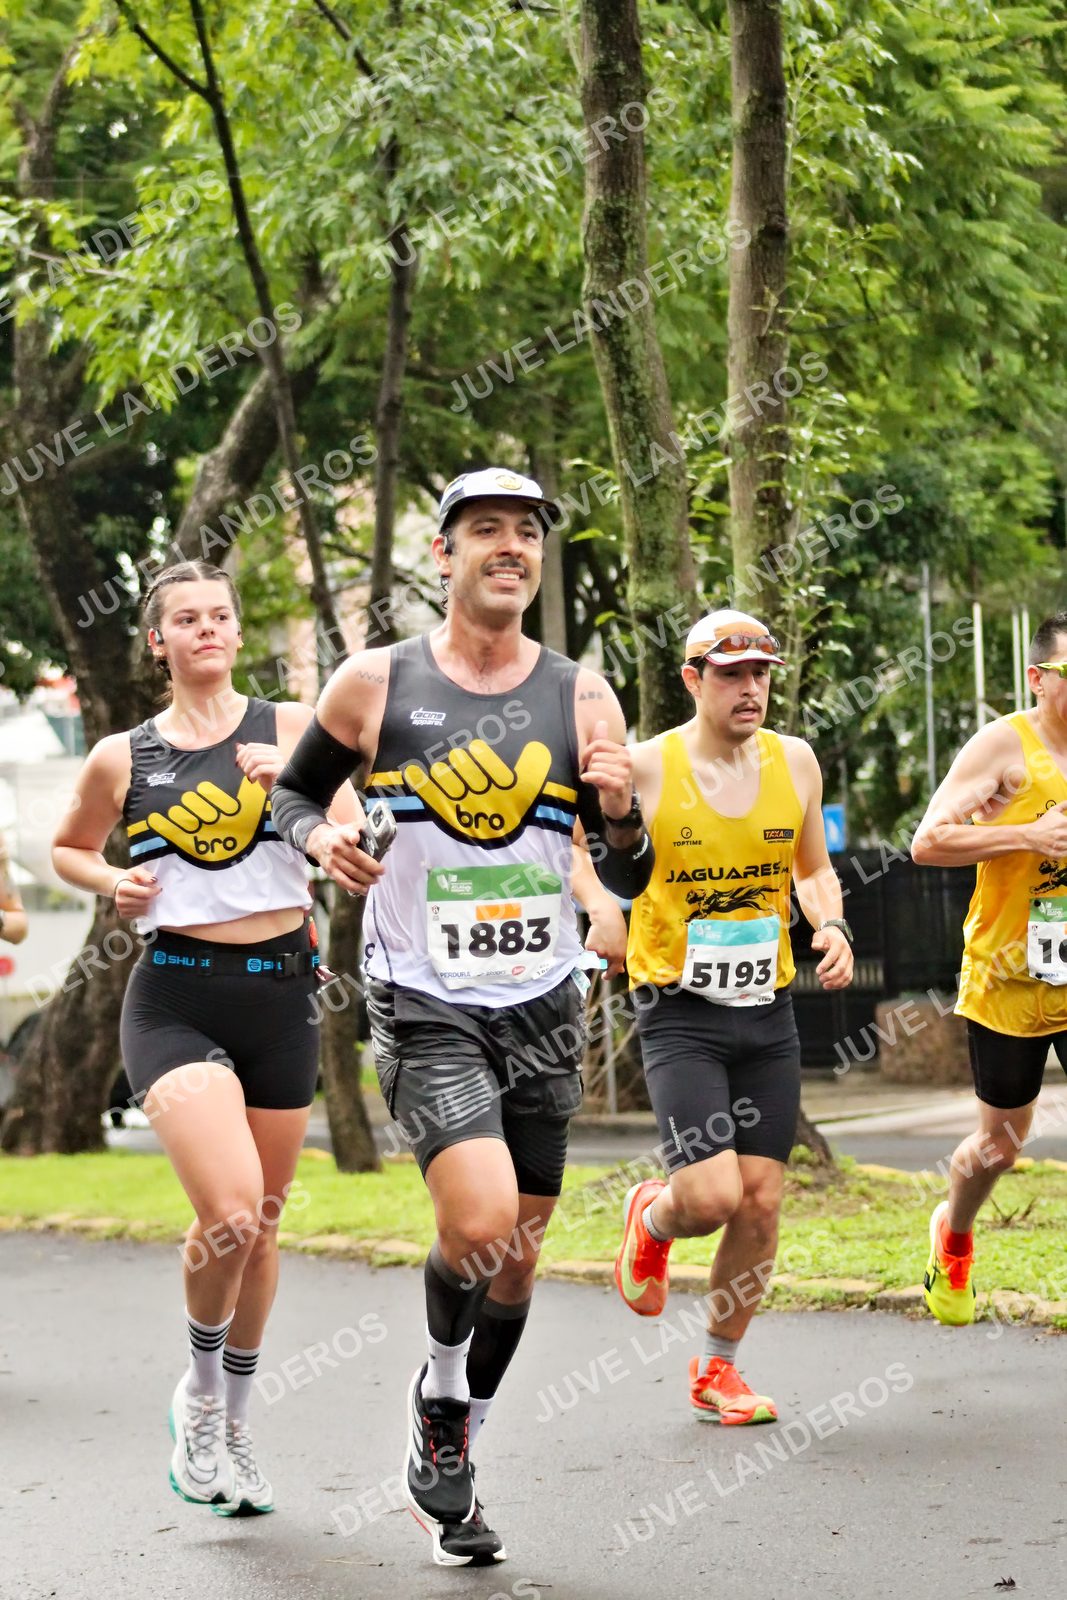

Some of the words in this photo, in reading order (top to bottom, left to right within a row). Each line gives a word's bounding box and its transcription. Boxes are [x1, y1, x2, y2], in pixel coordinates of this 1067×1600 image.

[455, 804, 506, 831] bro
[193, 835, 238, 855] bro
[672, 840, 703, 848] TOPTIME
[665, 861, 782, 883] JAGUARES
[440, 917, 551, 960] 1883
[688, 957, 772, 989] 5193
[668, 1116, 683, 1153] SALOMON
